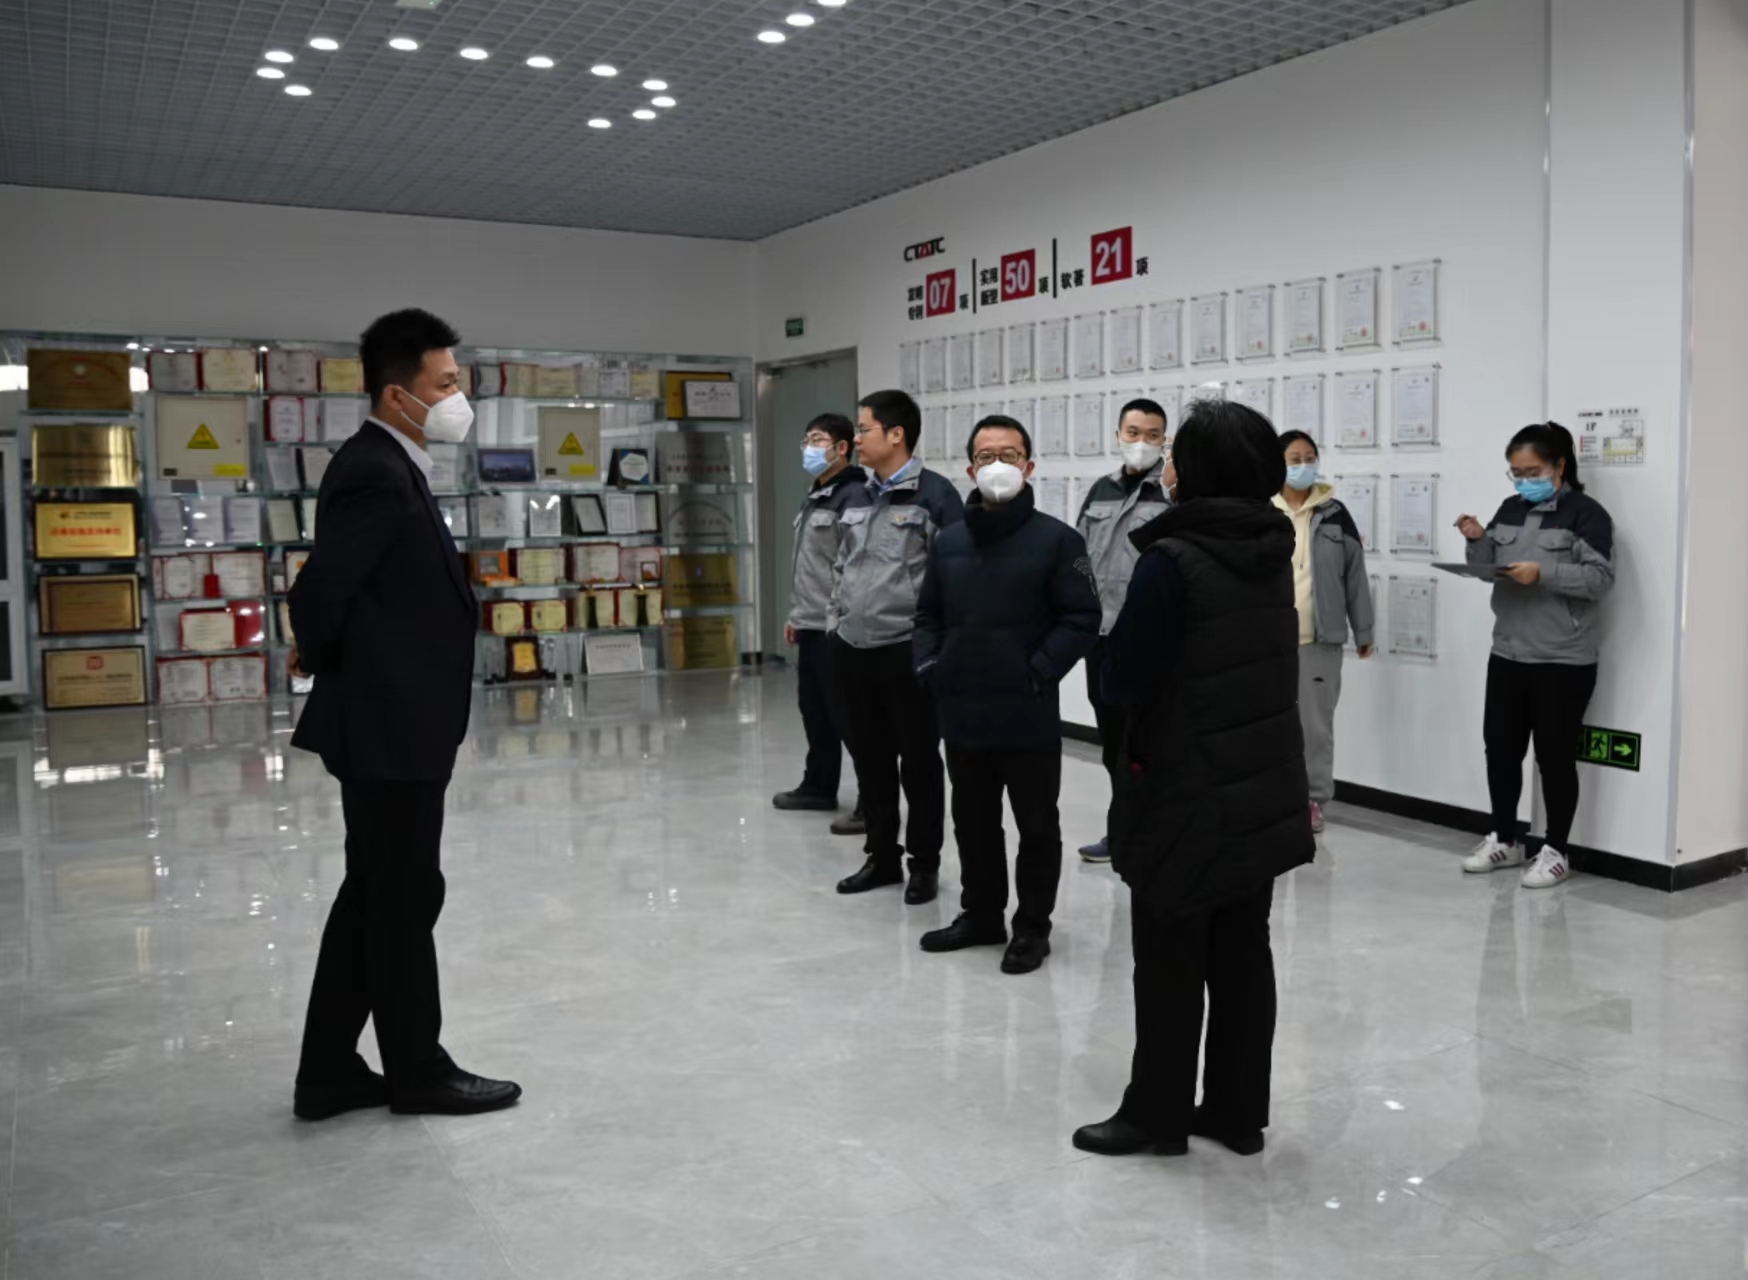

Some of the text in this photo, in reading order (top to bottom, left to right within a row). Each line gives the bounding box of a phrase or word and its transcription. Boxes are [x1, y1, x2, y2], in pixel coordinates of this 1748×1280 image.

[1095, 236, 1121, 277] 21
[930, 277, 951, 310] 07
[1005, 258, 1030, 294] 50
